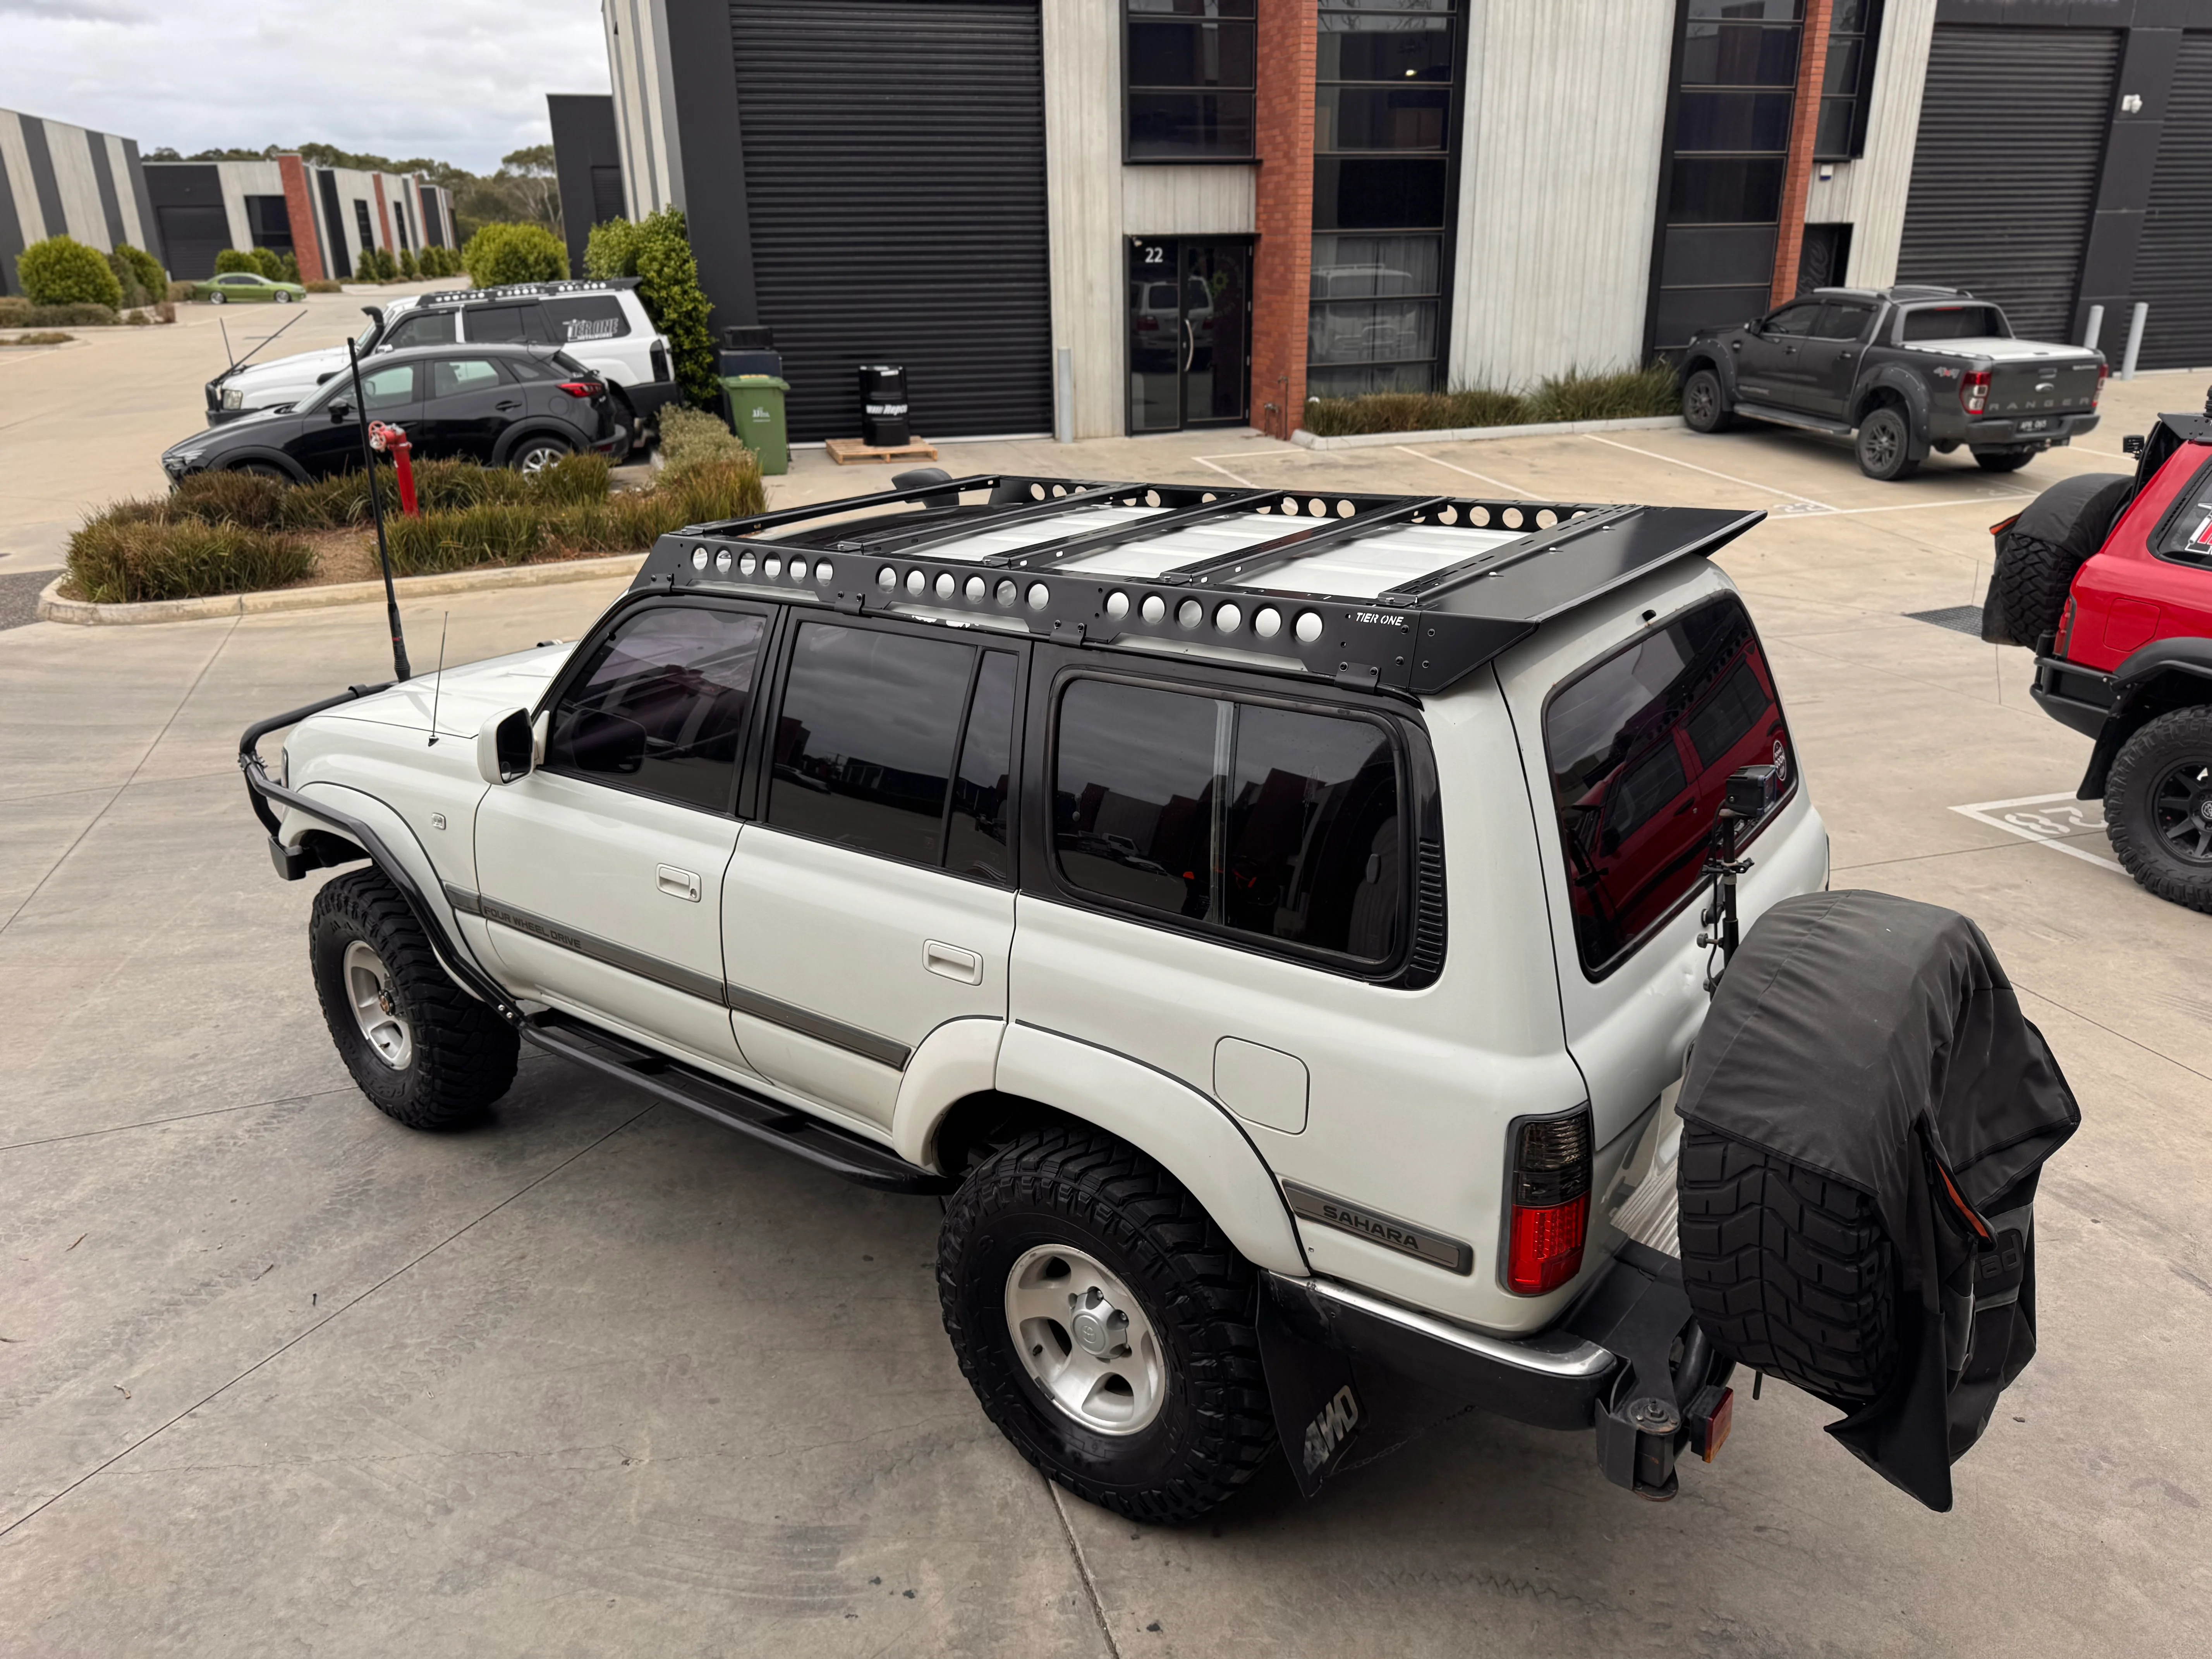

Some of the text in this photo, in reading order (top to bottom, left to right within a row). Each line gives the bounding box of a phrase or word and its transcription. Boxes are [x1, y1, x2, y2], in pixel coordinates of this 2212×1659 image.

[1145, 247, 1163, 263] 22
[593, 318, 618, 334] ONE
[1989, 397, 2090, 411] RANGER
[1356, 612, 1404, 626] TIER ONE
[484, 905, 582, 949] FOUR WHEEL DRIVE
[1323, 1205, 1419, 1250] SAHARA
[1303, 1385, 1358, 1475] 4WD
